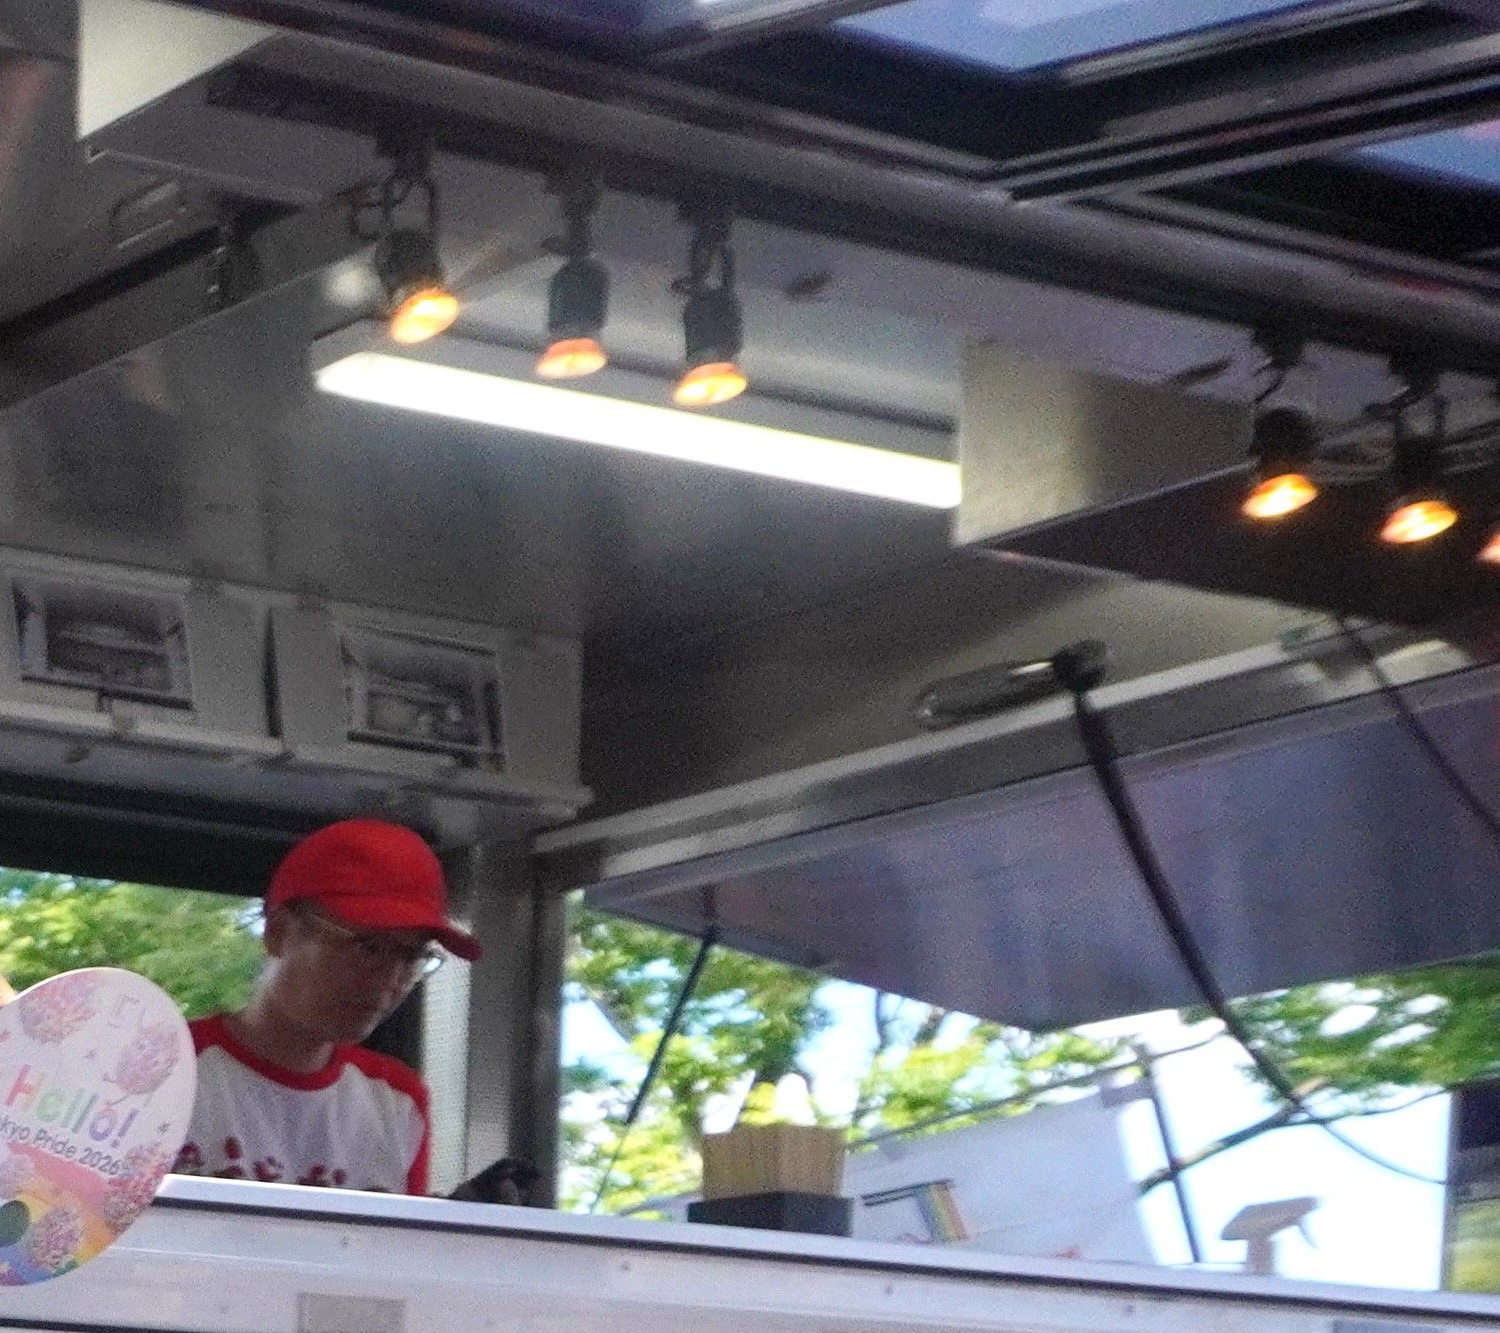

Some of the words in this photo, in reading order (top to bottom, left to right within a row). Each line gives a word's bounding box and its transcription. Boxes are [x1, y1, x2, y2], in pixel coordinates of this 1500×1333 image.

[5, 1064, 140, 1148] Hello!
[34, 1128, 77, 1159] Pride
[78, 1146, 122, 1176] 2026
